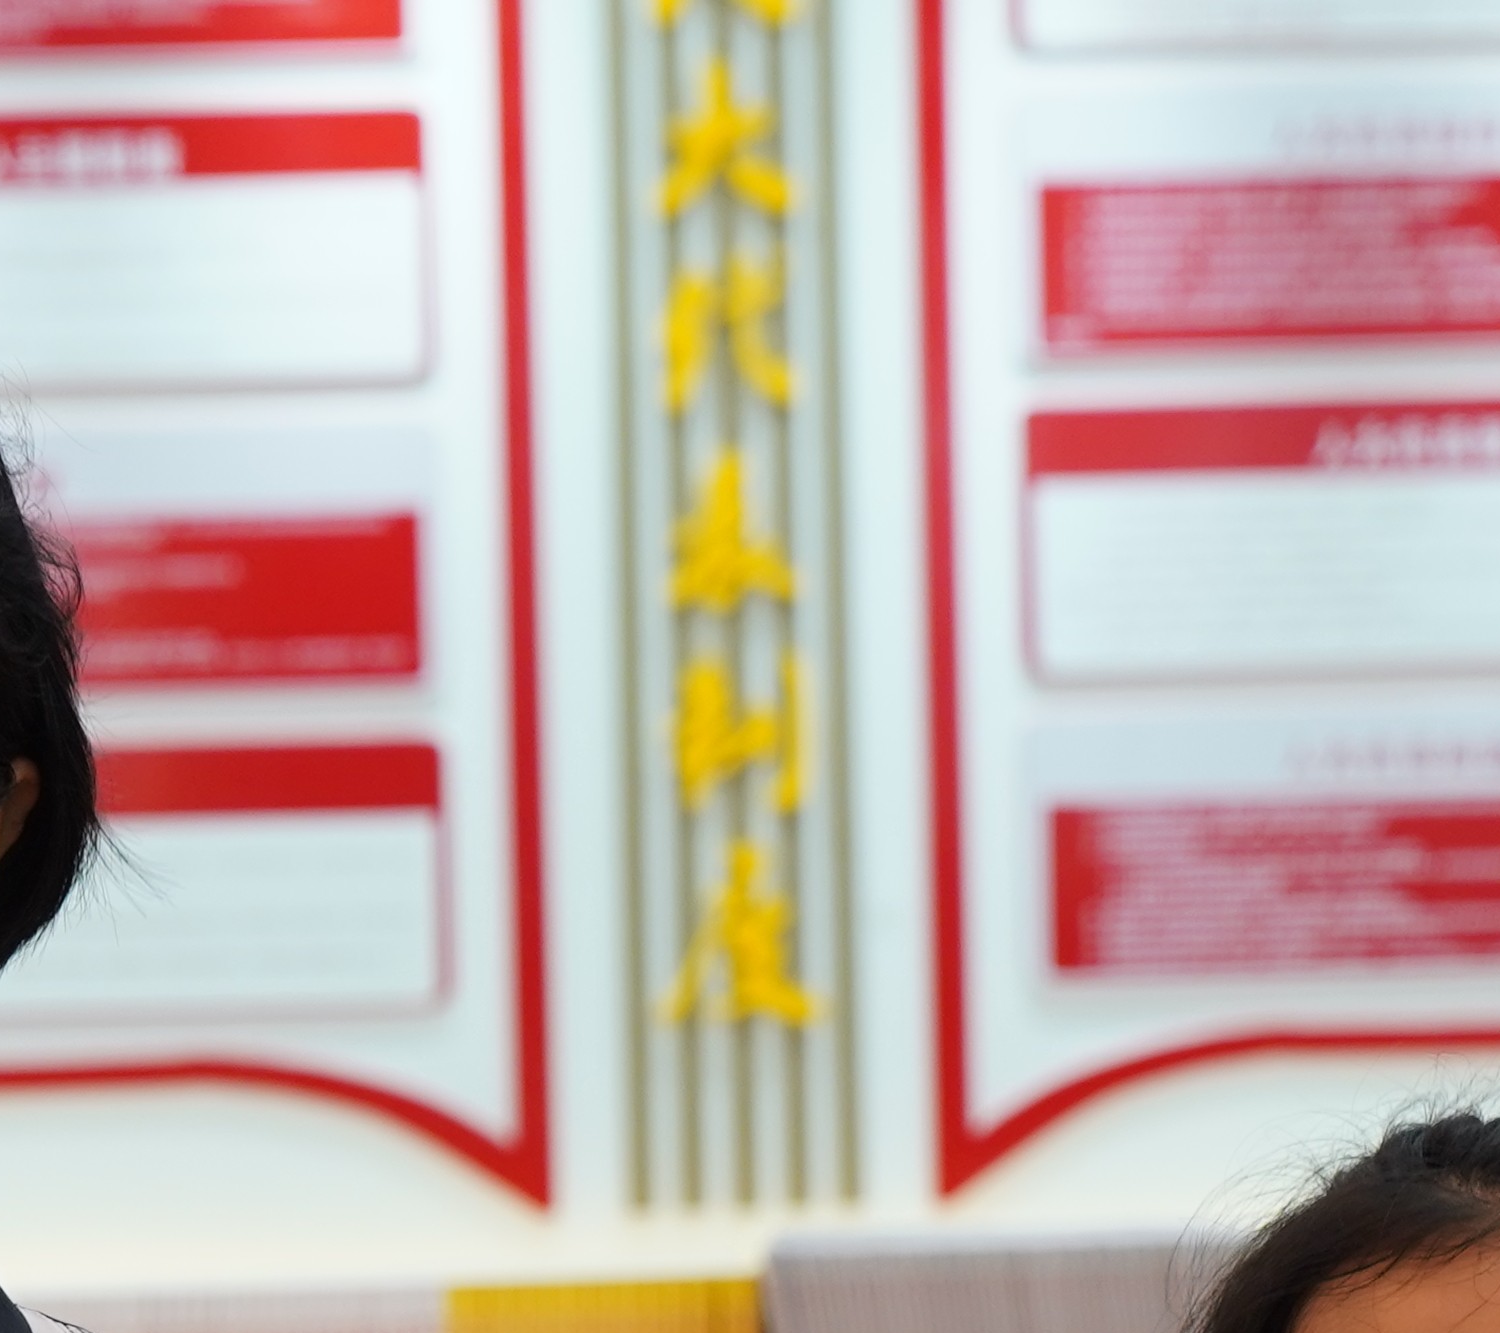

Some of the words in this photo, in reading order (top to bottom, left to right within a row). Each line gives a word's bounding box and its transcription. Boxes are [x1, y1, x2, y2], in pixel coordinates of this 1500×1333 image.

[652, 0, 823, 1028] 大代表制度
